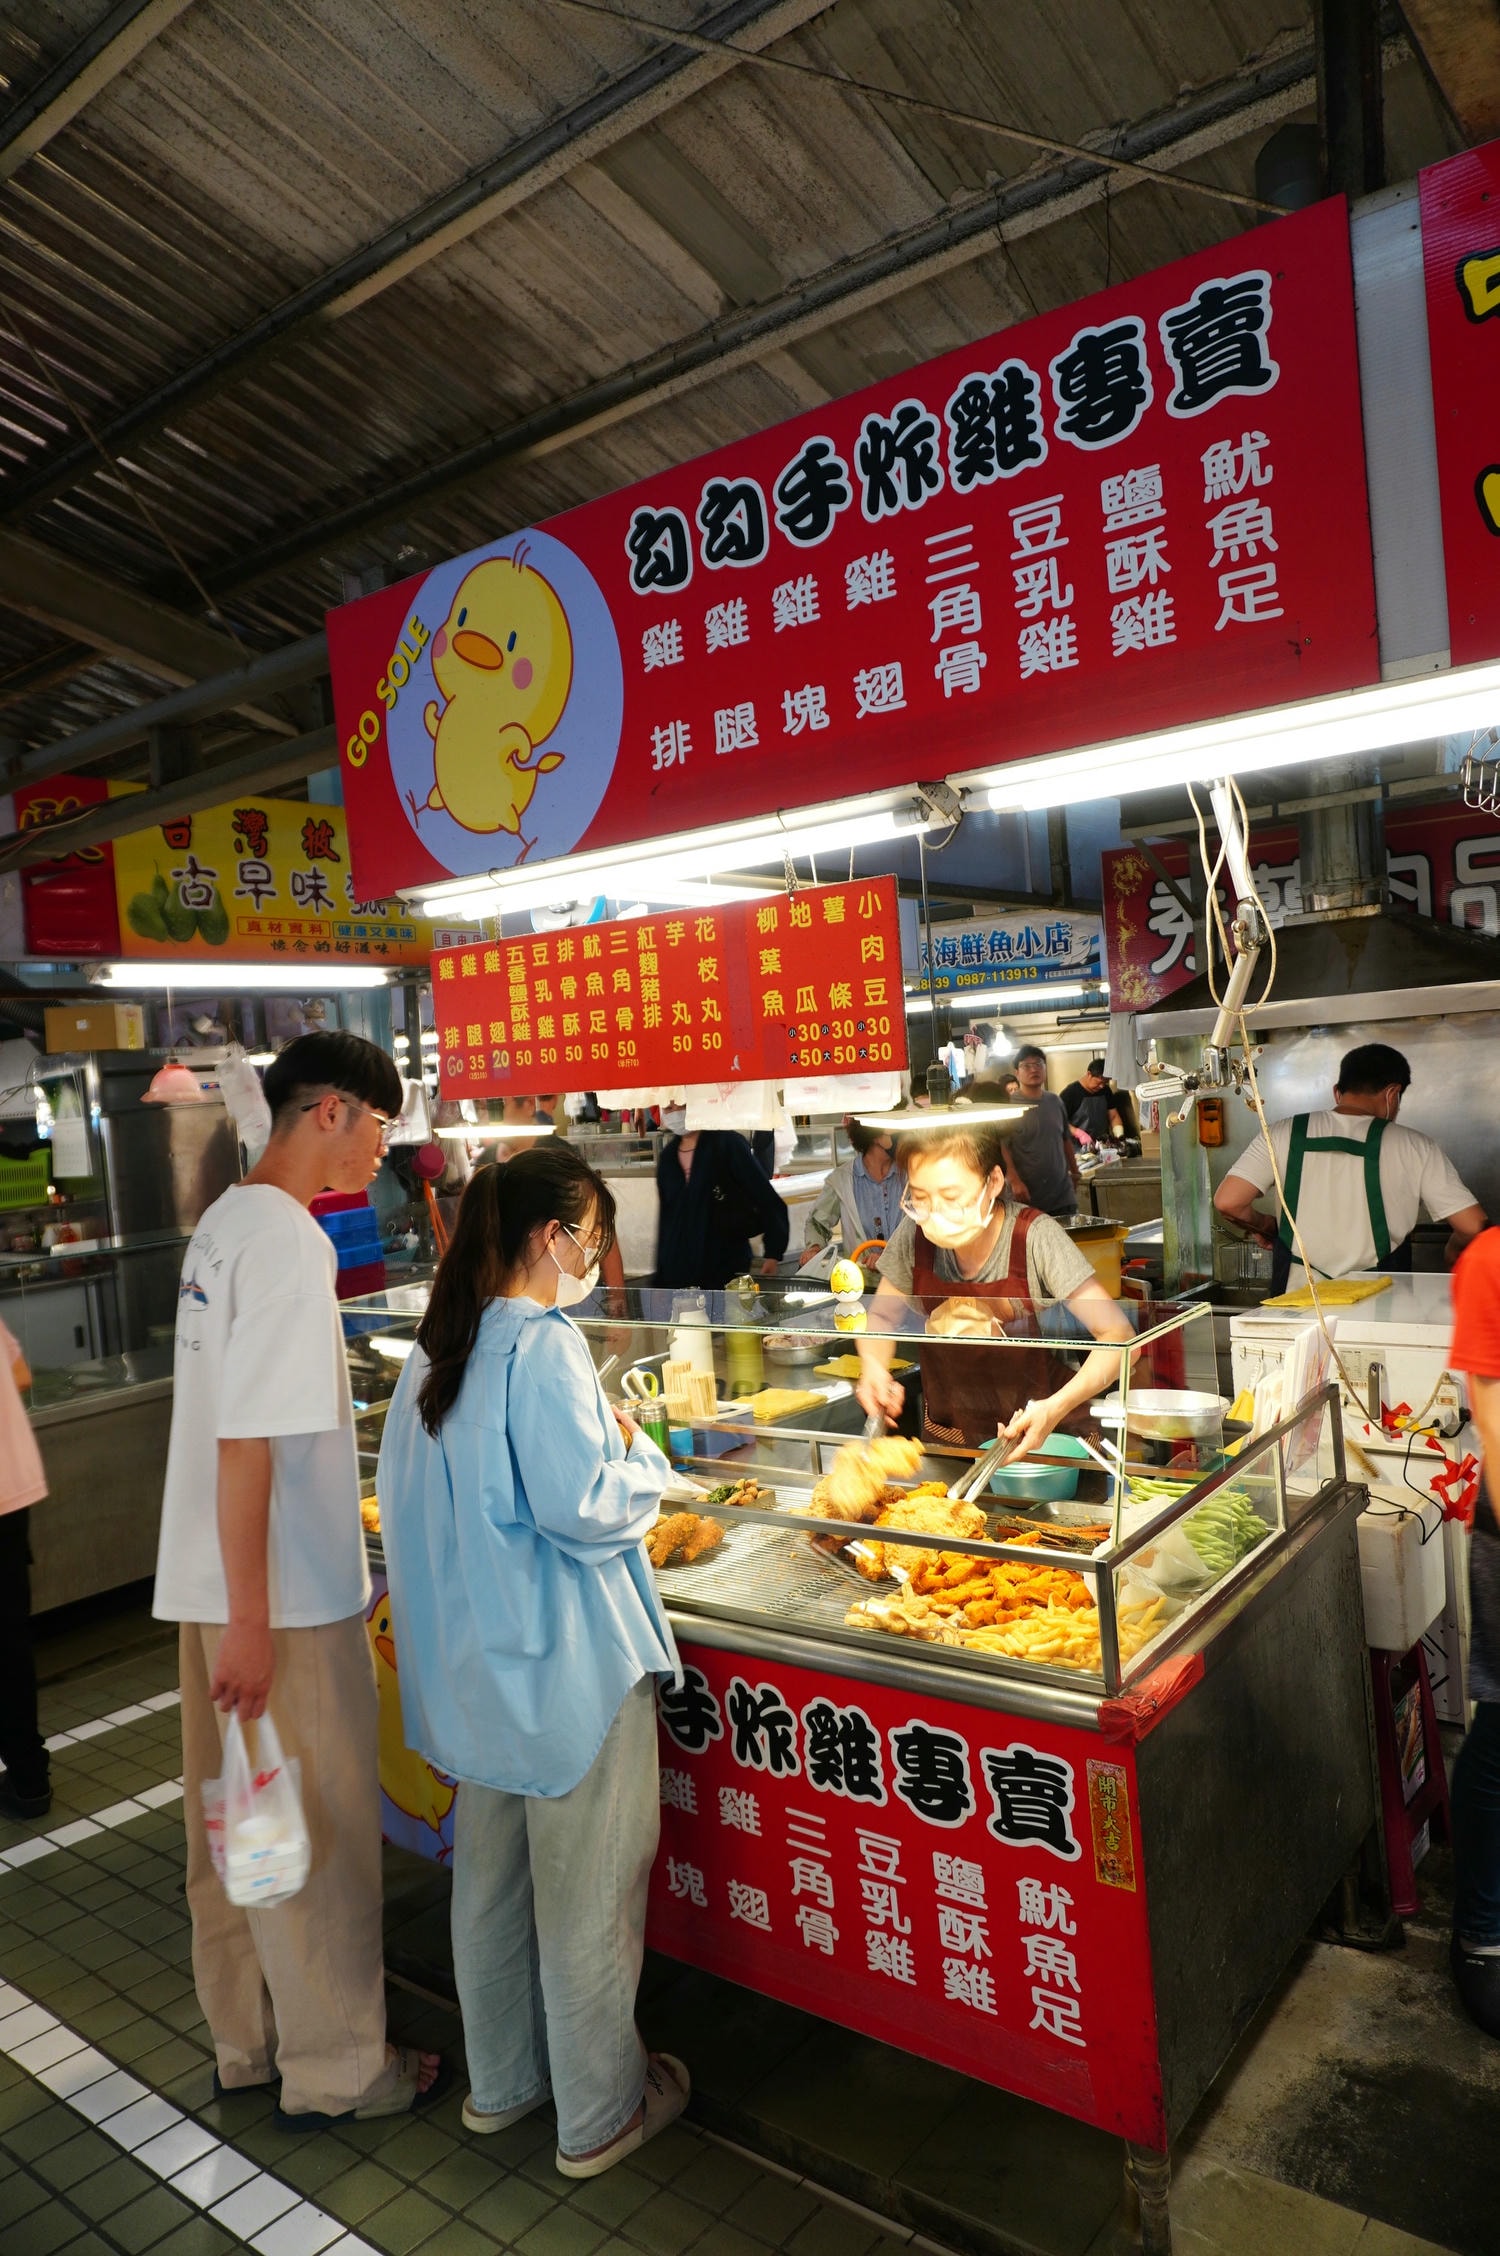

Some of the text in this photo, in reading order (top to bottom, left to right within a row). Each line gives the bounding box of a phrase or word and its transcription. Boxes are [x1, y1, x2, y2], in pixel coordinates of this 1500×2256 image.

[624, 269, 1281, 595] 勾勾手炸雞專賣
[1008, 493, 1080, 681] 豆乳雞
[1100, 462, 1178, 658] 鹽酥雞
[1199, 429, 1285, 632] 魷魚足
[771, 572, 831, 738] 雞塊
[844, 547, 908, 719] 雞翅
[924, 523, 988, 699] 三角骨
[346, 614, 432, 768] GO SOLE
[641, 618, 694, 772] 雞排
[704, 596, 760, 756] 雞腿
[337, 924, 414, 939] 健康又美味
[556, 937, 581, 1037] 排骨酥
[582, 934, 608, 1034] 魷魚足
[610, 929, 635, 1032] 三角骨
[664, 921, 692, 1027] 芋丸
[694, 917, 722, 1023] 花枝丸
[756, 907, 785, 1017] 柳葉魚
[788, 901, 818, 1014] 地瓜
[822, 896, 853, 1011] 薯條
[857, 890, 889, 1007] 小肉豆
[956, 966, 1038, 987] 0987-113913
[438, 957, 461, 1049] 雞排
[460, 953, 483, 1048] 雞腿
[483, 949, 507, 1044] 雞翅
[506, 945, 532, 1042] 五香鹽酥雞
[532, 942, 556, 1040] 豆乳雞
[798, 1023, 820, 1043] 30
[831, 1019, 855, 1039] 30
[867, 1016, 891, 1036] 30
[469, 1054, 486, 1071] 35
[492, 1049, 510, 1068] 20
[515, 1050, 532, 1066] 50
[540, 1047, 557, 1063] 50
[565, 1045, 583, 1061] 50
[591, 1042, 609, 1059] 50
[617, 1040, 636, 1057] 50
[672, 1035, 692, 1053] 50
[701, 1032, 722, 1051] 50
[800, 1047, 823, 1067] 50
[833, 1045, 857, 1065] 50
[868, 1042, 892, 1061] 50
[657, 1663, 1083, 1862] 手炸雞專賣
[1097, 1775, 1121, 1852] 開市大吉
[658, 1766, 708, 1908] 雞塊
[717, 1786, 773, 1933] 雞翅
[784, 1806, 840, 1956] 三角骨
[855, 1827, 918, 1986] 豆乳雞
[932, 1850, 999, 2016] 鹽酥雞
[1015, 1876, 1087, 2048] 魷魚足
